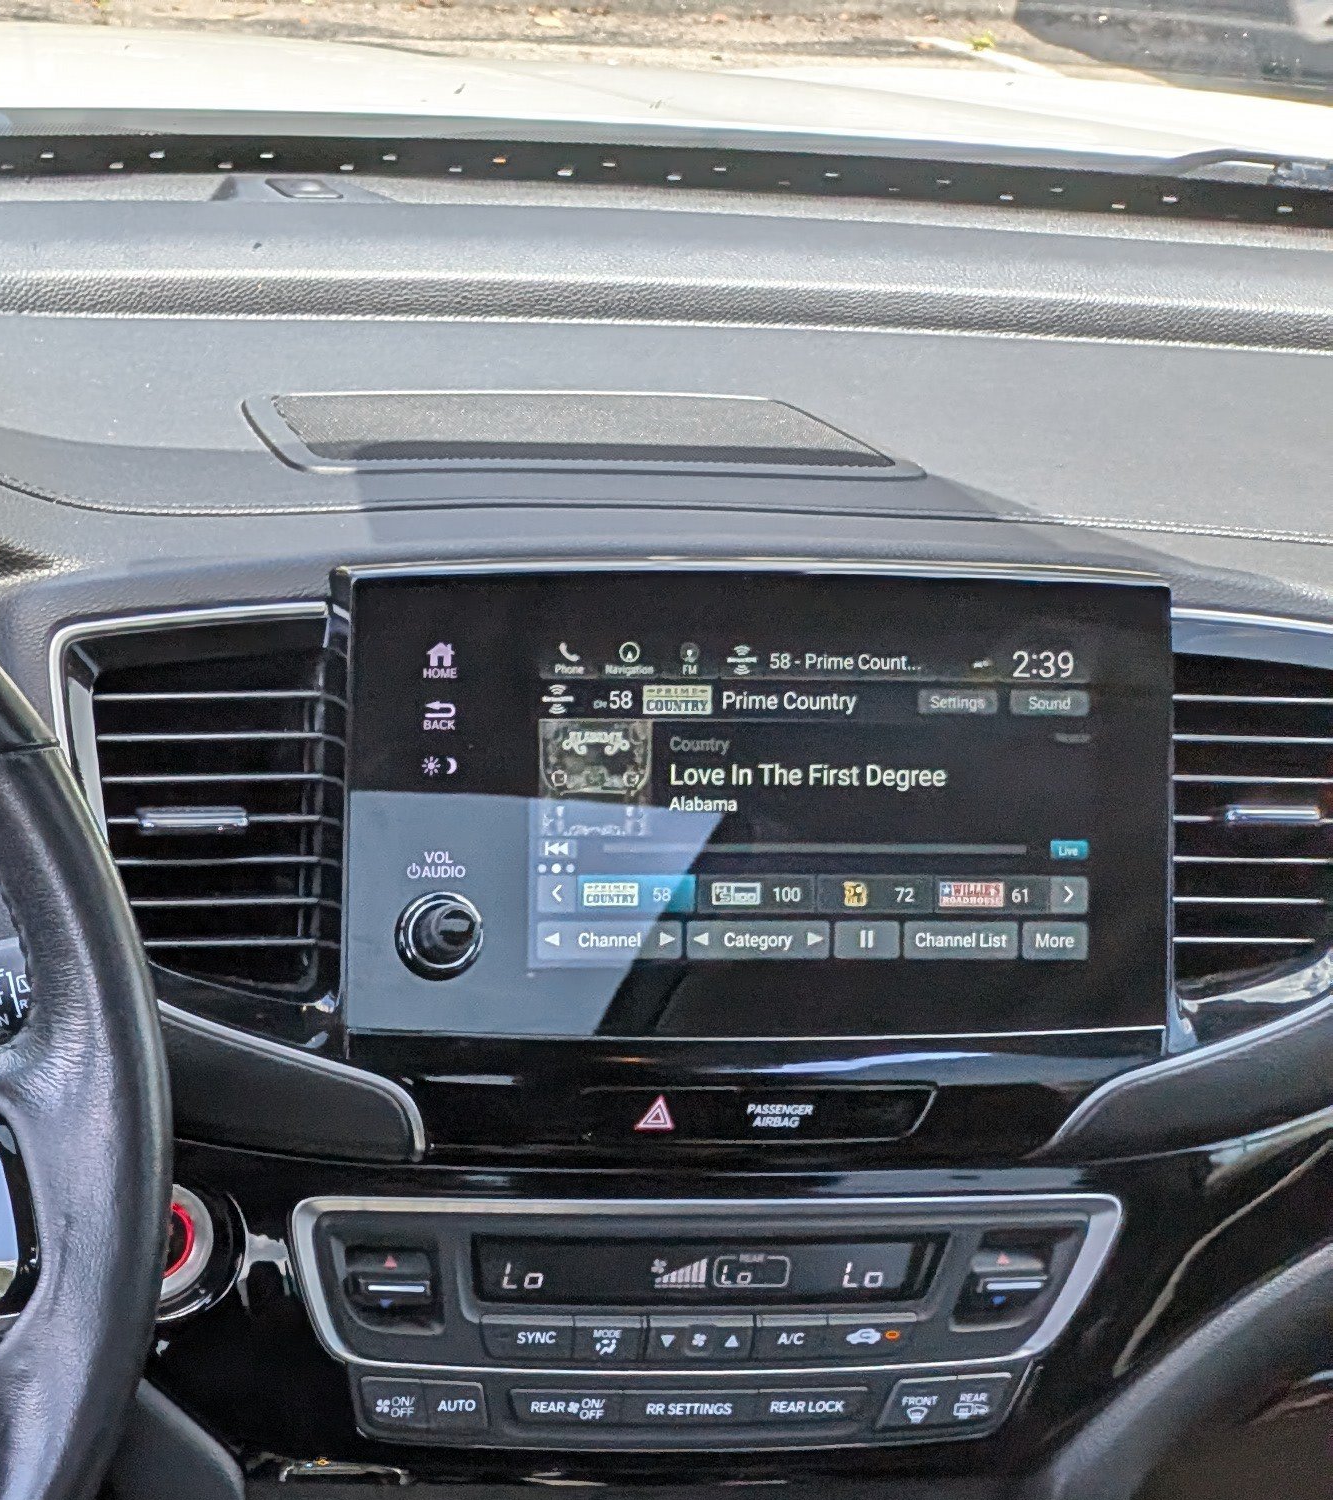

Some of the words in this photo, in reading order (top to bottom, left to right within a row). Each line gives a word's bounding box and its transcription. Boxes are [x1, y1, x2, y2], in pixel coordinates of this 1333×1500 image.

[769, 652, 792, 669] 58
[805, 653, 854, 670] Prime
[1012, 650, 1074, 678] 2:39
[423, 668, 457, 679] HOME
[554, 664, 585, 675] Phone
[604, 664, 654, 677] Navigation
[683, 665, 698, 675] FM
[609, 690, 633, 709] 58
[722, 692, 779, 710] Prime
[782, 692, 857, 714] Country
[930, 696, 986, 711] Settings
[1028, 697, 1072, 711] Sound
[646, 700, 709, 713] COUNTRY
[423, 720, 456, 731] BACK
[669, 736, 731, 755] Country
[670, 764, 726, 786] Love
[732, 764, 752, 786] In
[758, 764, 803, 786] The
[808, 764, 860, 786] First
[865, 765, 947, 792] Degree
[669, 797, 738, 812] Alabama
[424, 851, 454, 864] VOL
[1058, 845, 1078, 857] Live
[422, 866, 466, 878] AUDIO
[586, 893, 636, 904] COUNTRY
[653, 888, 672, 901] 58
[773, 887, 801, 902] 100
[894, 887, 915, 902] 72
[1011, 888, 1029, 903] 61
[578, 932, 642, 948] Channel
[724, 932, 793, 950] Category
[915, 932, 979, 948] Channel
[980, 932, 1007, 948] List
[1035, 933, 1074, 948] More
[747, 1103, 813, 1115] PASSENGER
[752, 1116, 800, 1128] AIRBAG
[517, 1331, 557, 1345] SYNC
[593, 1329, 622, 1338] MODE
[777, 1332, 805, 1346] A/C
[391, 1396, 415, 1407] ON/
[581, 1398, 606, 1410] ON/
[901, 1396, 938, 1407] FRONT
[959, 1393, 988, 1403] REAR
[390, 1408, 415, 1418] OFF
[437, 1400, 476, 1413] AUTO
[531, 1401, 565, 1413] REAR
[646, 1403, 664, 1416] RR
[667, 1403, 732, 1417] SETTINGS
[770, 1401, 806, 1413] REAR
[808, 1401, 844, 1413] LOCK
[579, 1409, 604, 1420] OFF
